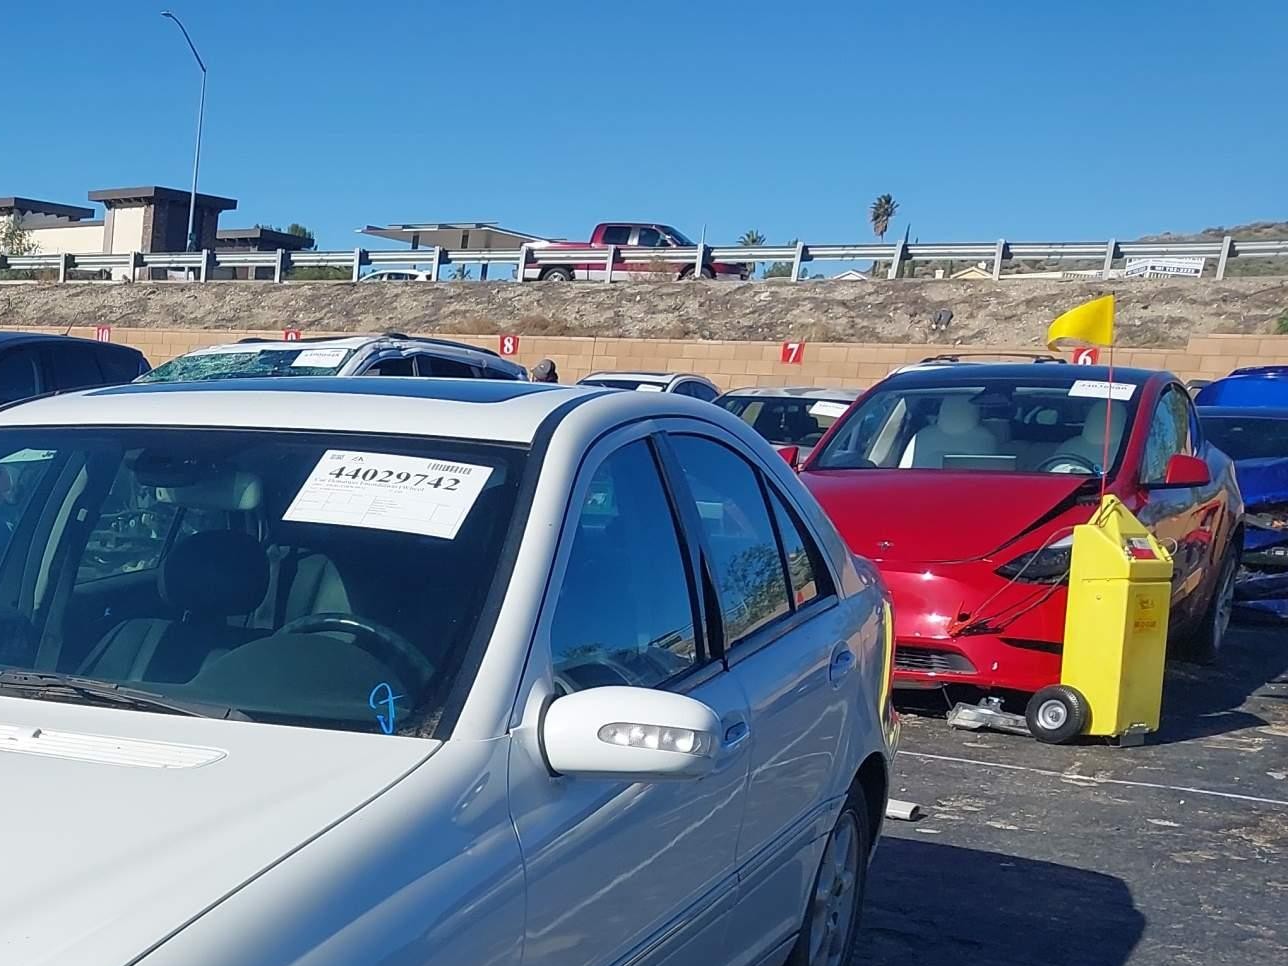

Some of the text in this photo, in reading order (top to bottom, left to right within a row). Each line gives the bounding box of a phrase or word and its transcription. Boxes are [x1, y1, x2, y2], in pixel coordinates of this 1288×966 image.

[98, 327, 110, 342] 10
[504, 336, 513, 354] 8
[787, 343, 800, 364] 7
[1078, 348, 1094, 365] 6
[328, 466, 461, 492] 44029742
